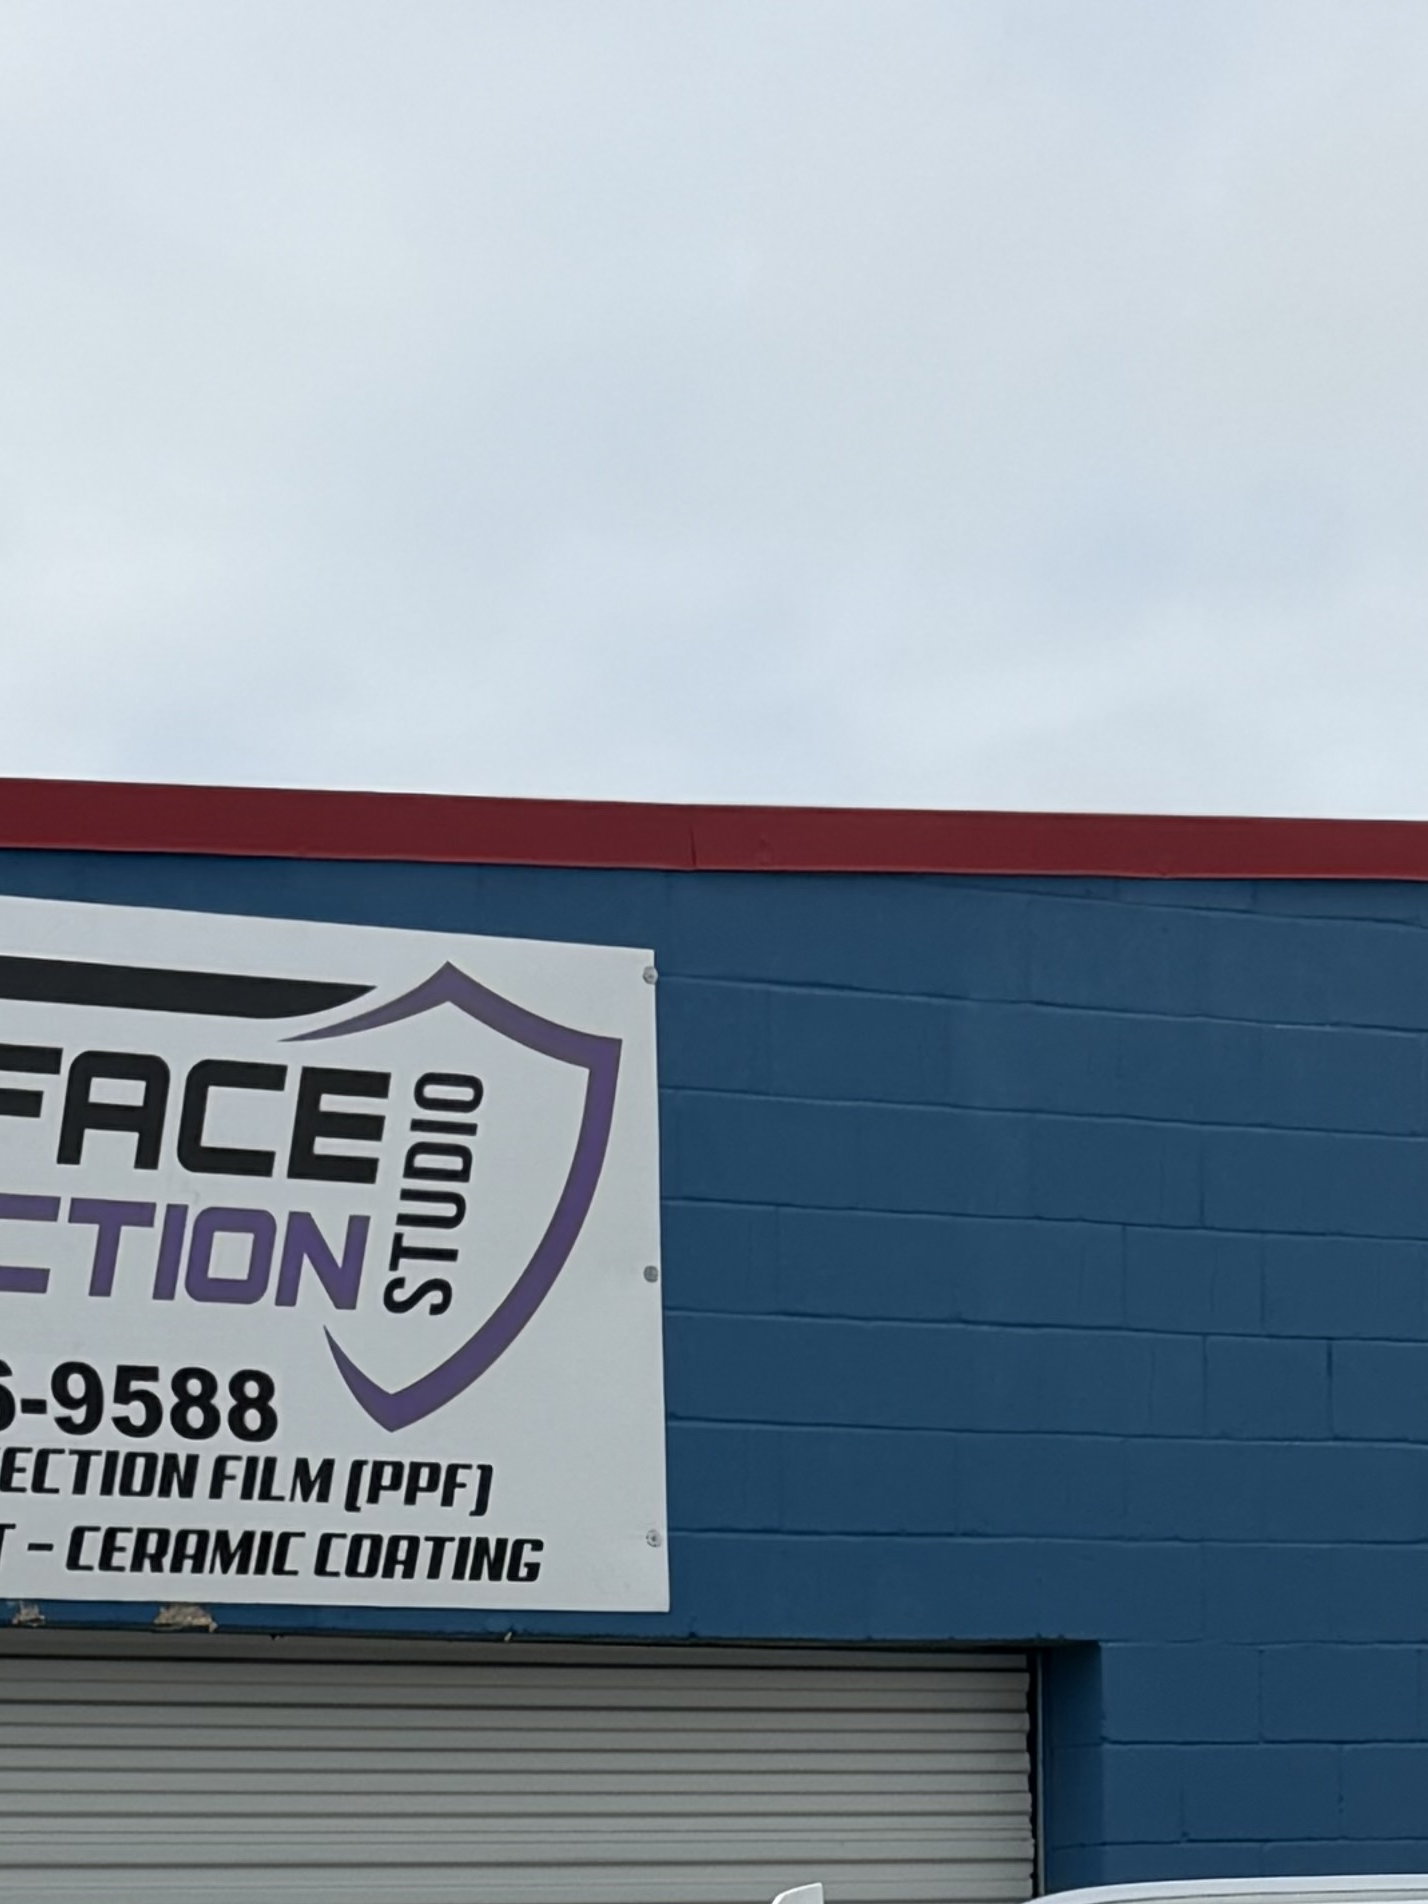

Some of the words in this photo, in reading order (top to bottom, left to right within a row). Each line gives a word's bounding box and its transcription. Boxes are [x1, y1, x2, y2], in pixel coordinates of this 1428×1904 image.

[384, 1073, 483, 1315] STUDIO
[209, 1455, 335, 1502] FILM
[66, 1526, 306, 1576] CERAMIC
[314, 1533, 543, 1582] COATING
